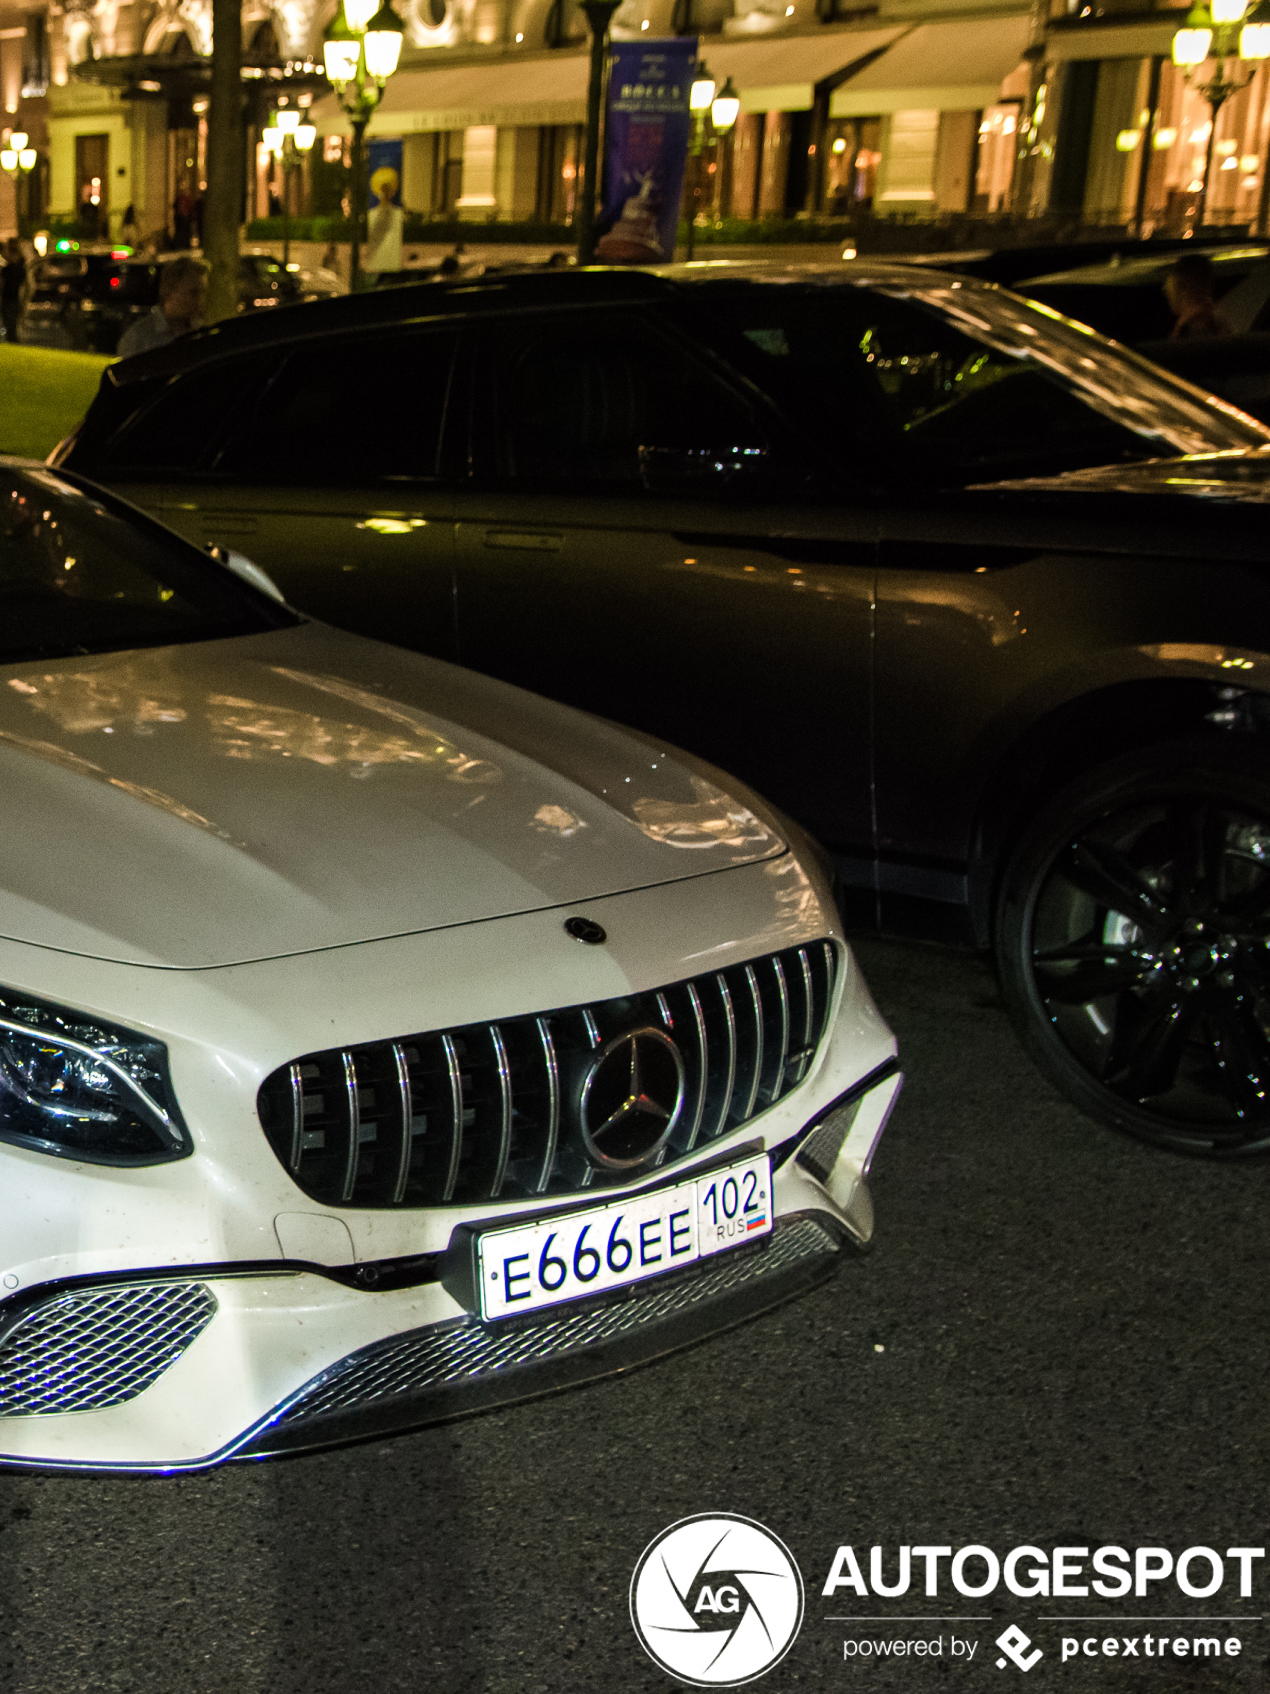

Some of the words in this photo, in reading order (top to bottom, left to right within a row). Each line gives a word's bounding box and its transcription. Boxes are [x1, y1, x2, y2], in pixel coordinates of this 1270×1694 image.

[503, 1208, 691, 1303] E666EE
[703, 1170, 758, 1226] 102
[716, 1218, 745, 1242] RUS
